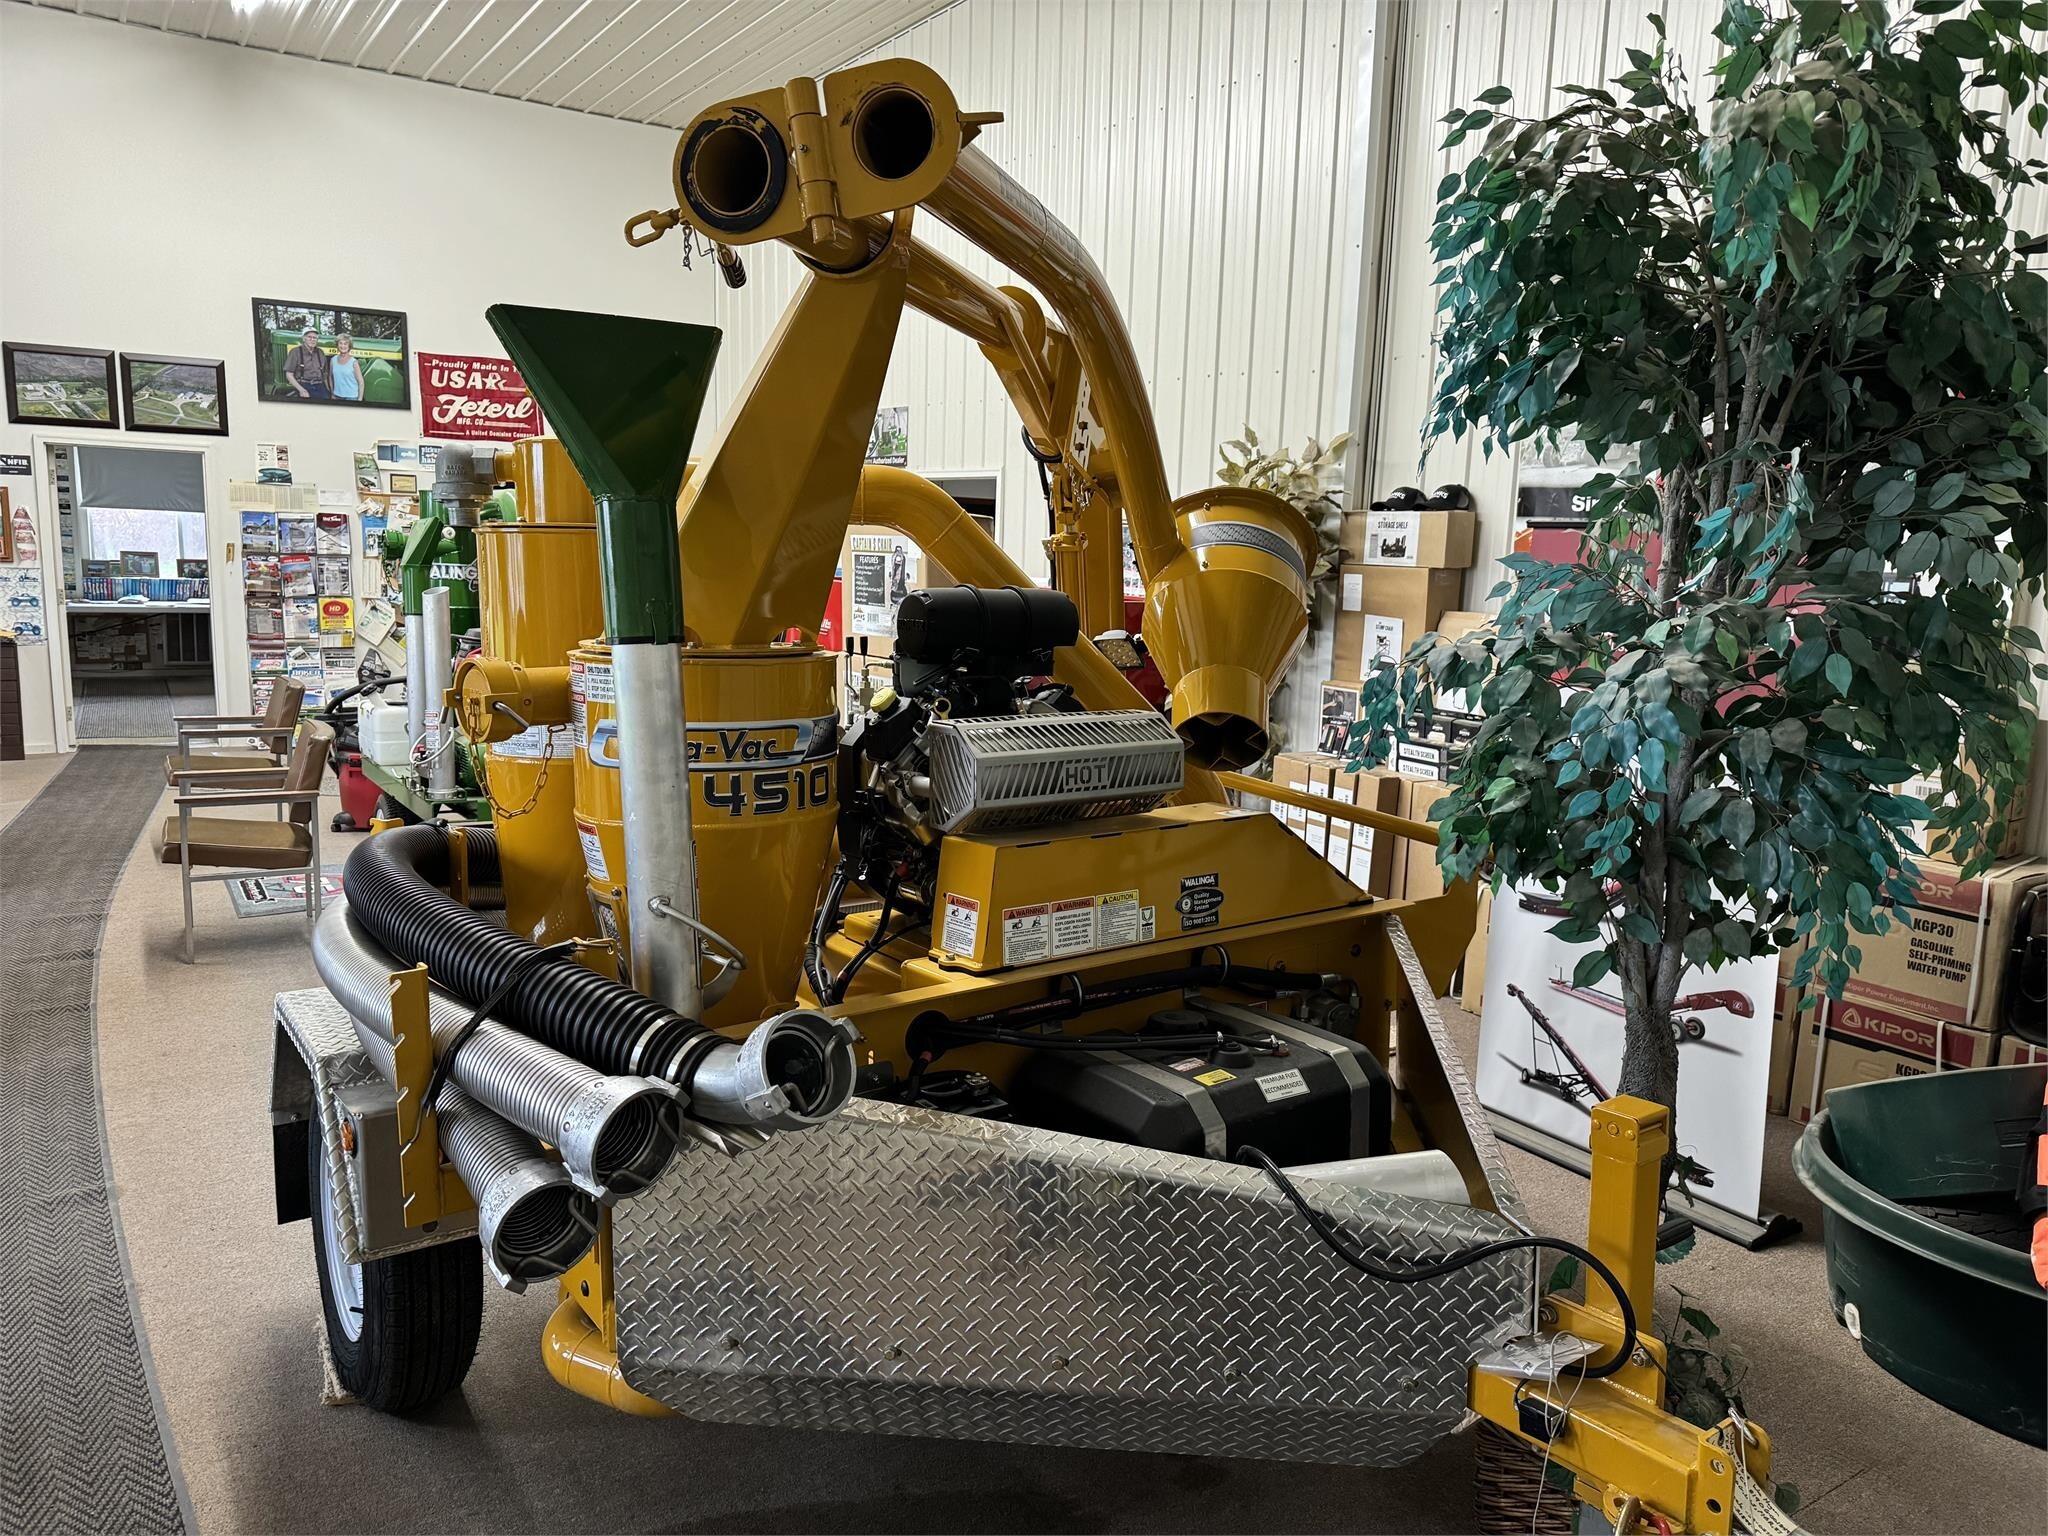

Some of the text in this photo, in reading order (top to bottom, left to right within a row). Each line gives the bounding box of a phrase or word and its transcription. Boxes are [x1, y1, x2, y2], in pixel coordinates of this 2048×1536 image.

[432, 358, 469, 370] Proudly
[472, 360, 498, 371] Made
[500, 364, 510, 372] In
[430, 368, 483, 390] USA
[432, 393, 534, 424] Feterl
[456, 417, 485, 426] MFG. CO.
[489, 430, 512, 438] Dominion
[1378, 521, 1408, 529] STORAGE SHELF
[877, 538, 892, 550] CHAIR
[860, 556, 879, 564] FEATURES
[430, 564, 478, 580] ALING
[587, 666, 611, 675] SHUTDOWN
[1403, 748, 1435, 760] STEALTH SCREEN
[1066, 764, 1106, 786] HOT
[1402, 764, 1434, 777] STEALTH SCREEN
[703, 763, 830, 816] 4510
[1184, 876, 1215, 887] WALINGA
[1108, 893, 1134, 902] CAUTION
[1194, 892, 1209, 900] Quality
[1016, 906, 1044, 916] WARNING
[1062, 900, 1090, 910] WARNING
[1194, 904, 1209, 912] System
[1913, 918, 1954, 938] KGP30
[1910, 937, 1954, 956] GASOLINE
[1908, 948, 1972, 973] SELF-PRIMING
[1907, 960, 1967, 983] WATER PUMP
[1866, 987, 1887, 998] Power
[1864, 1016, 1936, 1048] KIPOR
[1896, 1062, 1927, 1076] KGP
[1260, 1071, 1298, 1085] PREMIUM FUEL
[1264, 1080, 1304, 1095] RECOMMENDED
